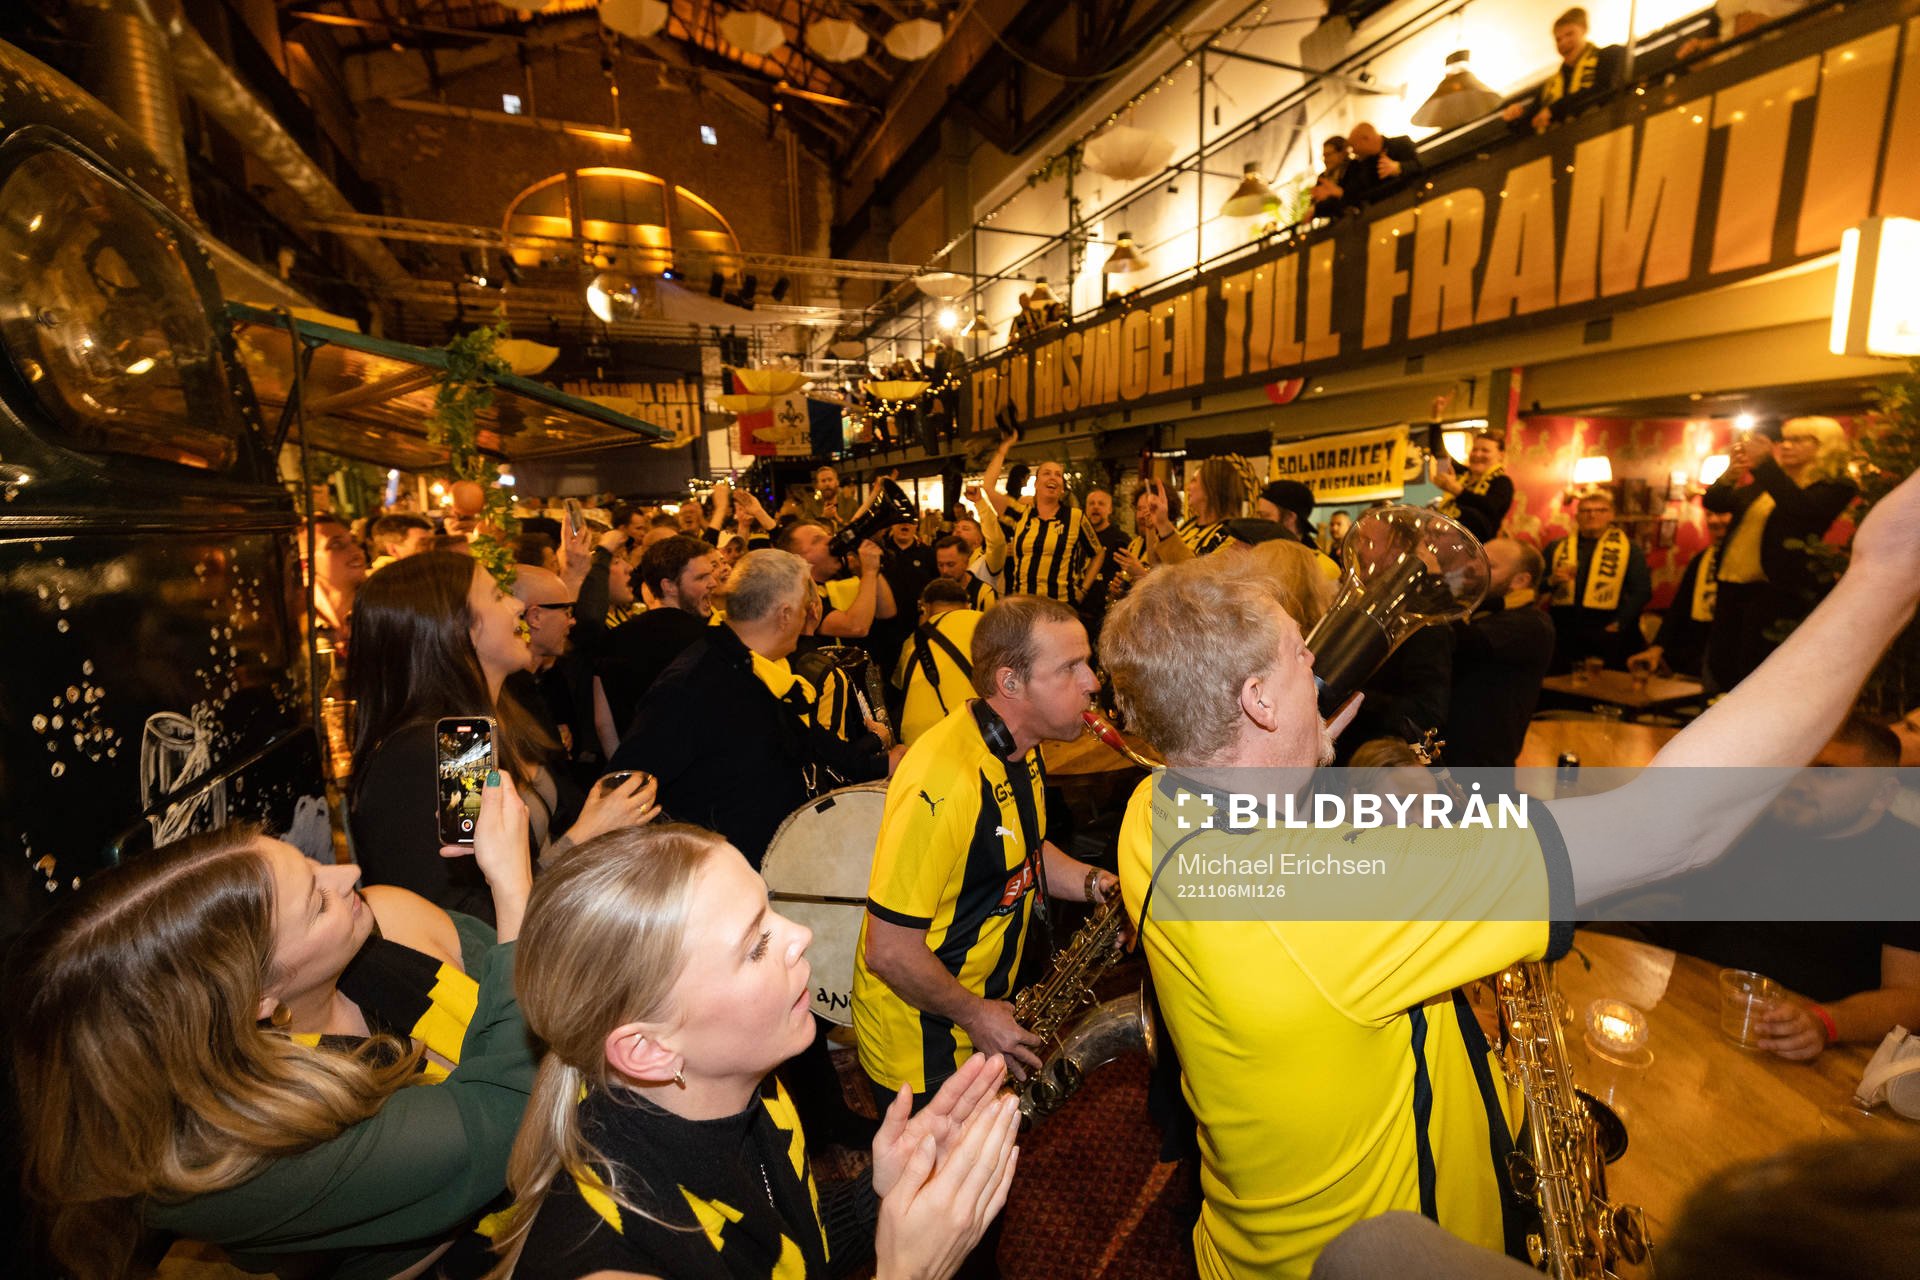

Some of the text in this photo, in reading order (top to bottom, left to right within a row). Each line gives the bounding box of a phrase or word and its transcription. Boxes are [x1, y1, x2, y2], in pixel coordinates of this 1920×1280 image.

[1034, 285, 1208, 418] HISINGEN
[1221, 238, 1340, 379] TILL
[1278, 439, 1396, 475] SOLIDARITET
[1598, 547, 1620, 578] 2022
